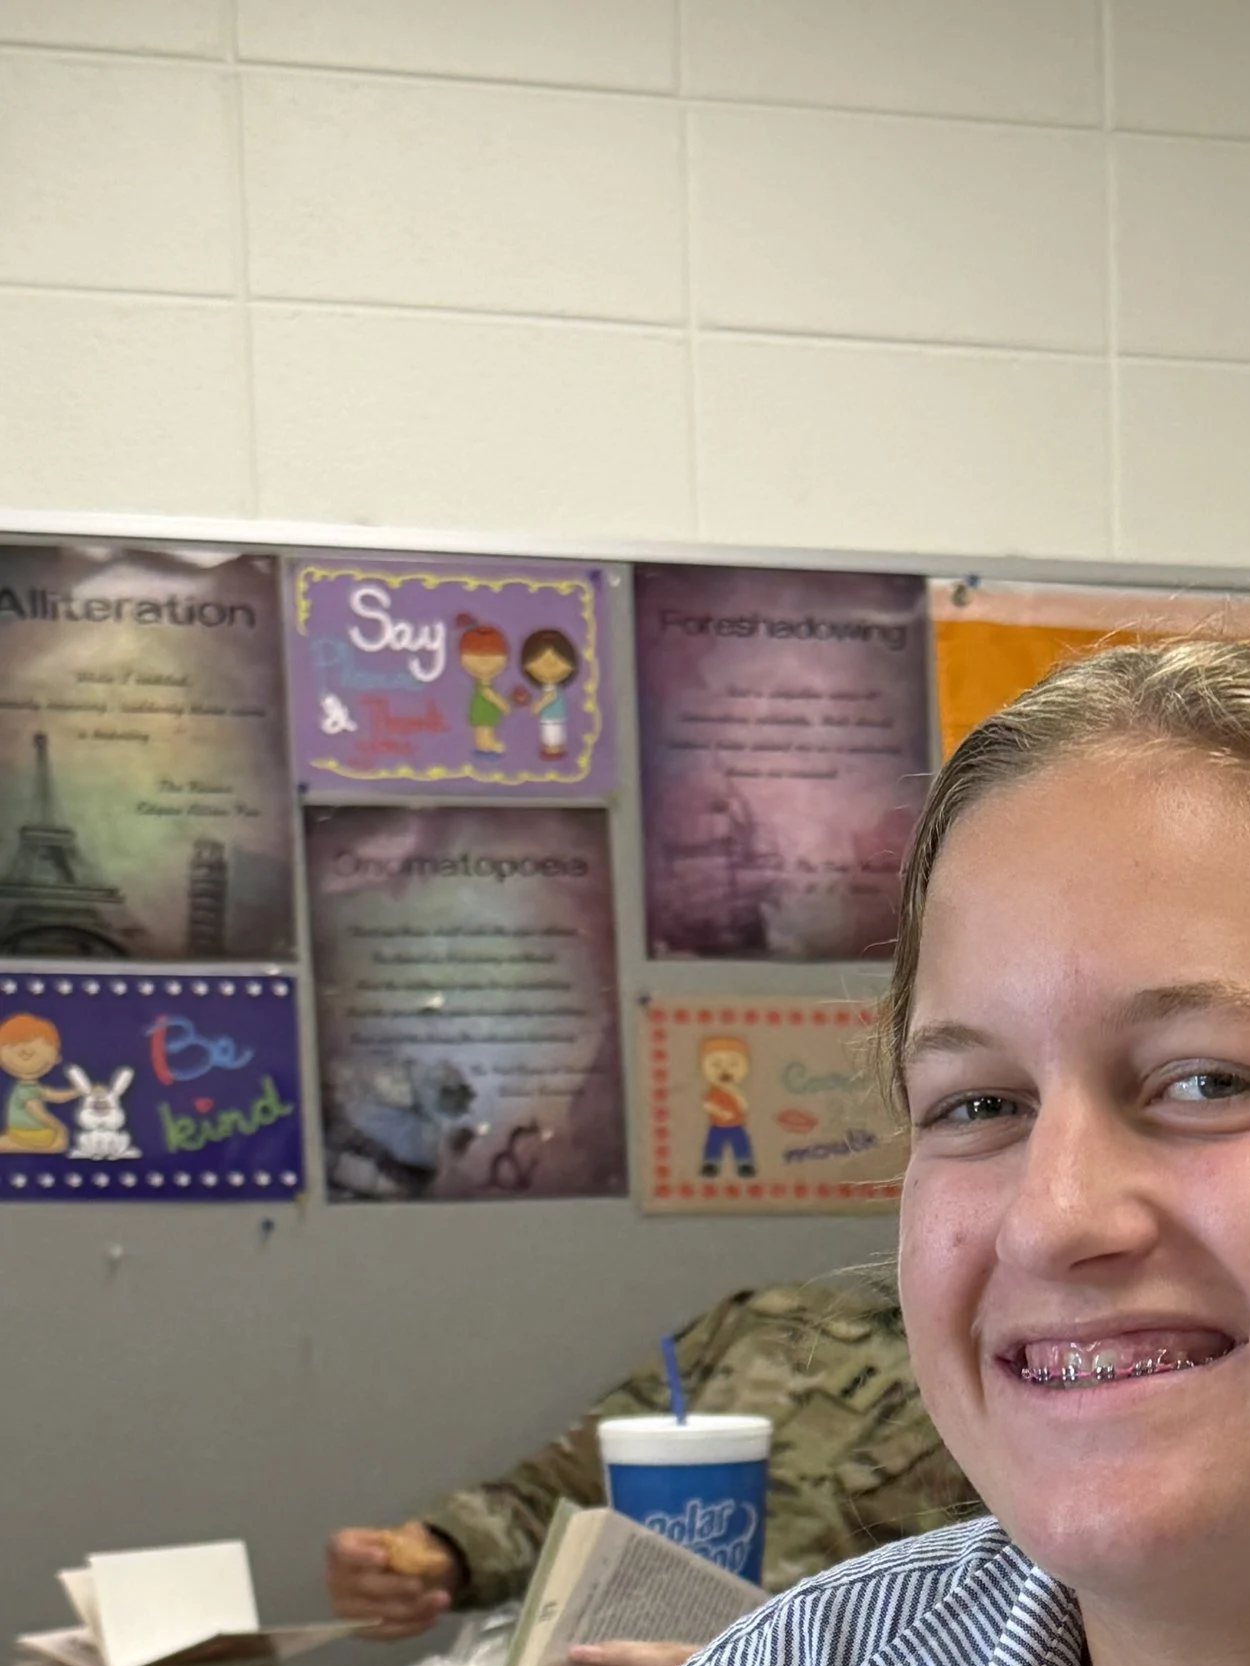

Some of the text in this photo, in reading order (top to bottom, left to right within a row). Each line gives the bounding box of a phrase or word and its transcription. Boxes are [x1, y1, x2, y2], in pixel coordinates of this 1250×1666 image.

[0, 588, 257, 629] Alliteration
[349, 585, 447, 682] Say
[659, 608, 908, 652] Foreshadowing
[319, 694, 358, 735] &
[146, 1015, 254, 1085] Be
[158, 1075, 292, 1153] kind
